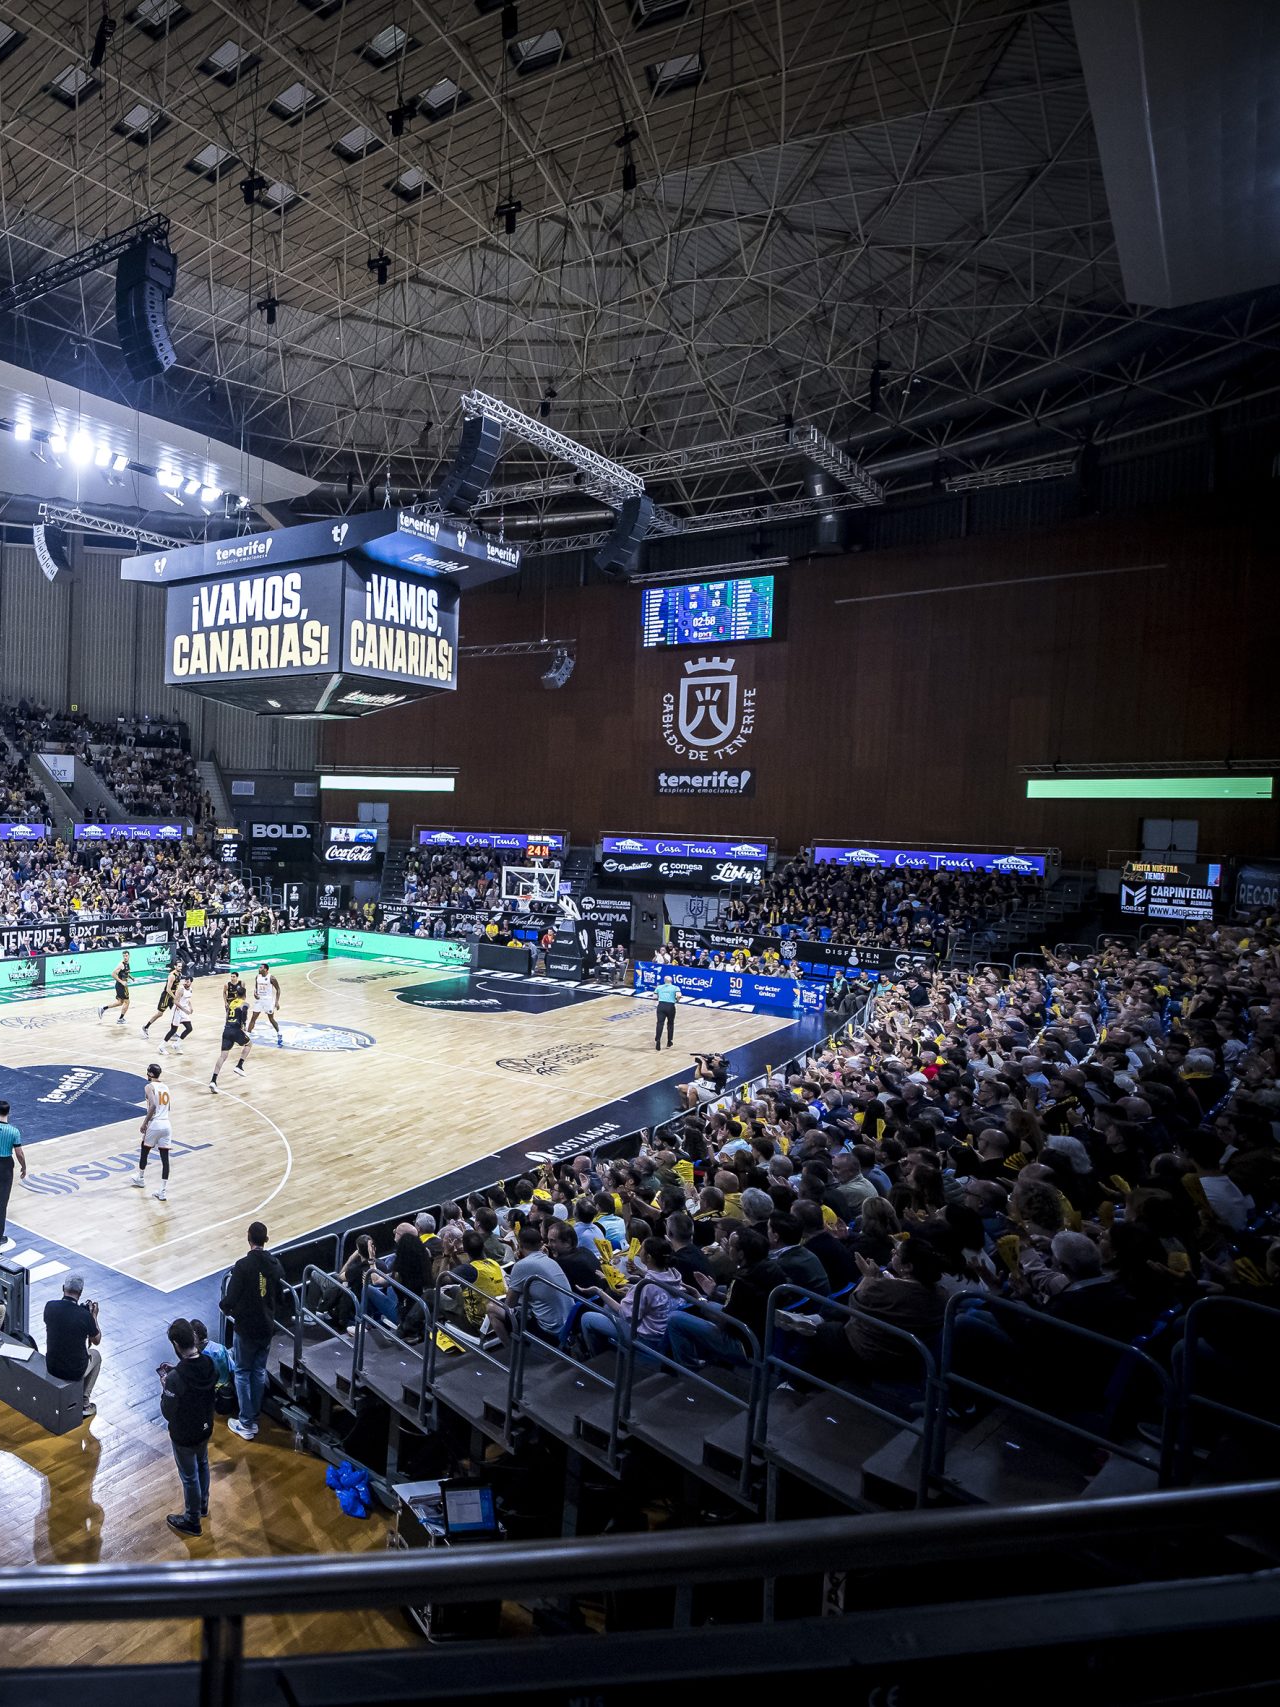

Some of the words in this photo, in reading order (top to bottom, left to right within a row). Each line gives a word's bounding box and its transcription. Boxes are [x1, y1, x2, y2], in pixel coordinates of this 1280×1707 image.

[400, 512, 439, 541] tenerife!
[216, 538, 272, 558] tenerife!
[487, 542, 520, 566] tenerife!
[192, 573, 308, 631] ¡VAMOS,
[366, 573, 441, 636] ¡VAMOS,
[173, 620, 329, 676] CANARIAS!
[350, 620, 452, 681] CANARIAS!
[662, 692, 686, 754] CABILDO
[688, 750, 709, 761] DE
[713, 688, 757, 760] TENERIFE
[658, 770, 751, 793] tenerife!
[252, 824, 311, 839] BOLD.
[466, 835, 489, 845] Casa
[489, 836, 520, 848] Tomás
[325, 844, 374, 862] Coca-Cola
[528, 845, 541, 856] 24
[655, 842, 681, 854] Casa
[682, 843, 717, 857] Tomás
[670, 863, 703, 871] comesa
[895, 853, 929, 867] Casa
[929, 854, 975, 870] Tomás
[1132, 863, 1150, 872] VISITA
[1152, 864, 1178, 873] NUESTRA
[711, 862, 762, 885] Libby's
[1144, 872, 1165, 881] TIENDA
[1151, 886, 1213, 900] CARPINTERIA
[378, 904, 408, 912] SPRING
[456, 913, 489, 922] EXPRESS
[581, 913, 628, 922] HOVIMA
[78, 925, 99, 938] DXT
[106, 925, 129, 934] Pabellón
[677, 940, 700, 949] TCL
[729, 977, 743, 989] 50
[158, 1092, 170, 1106] 10
